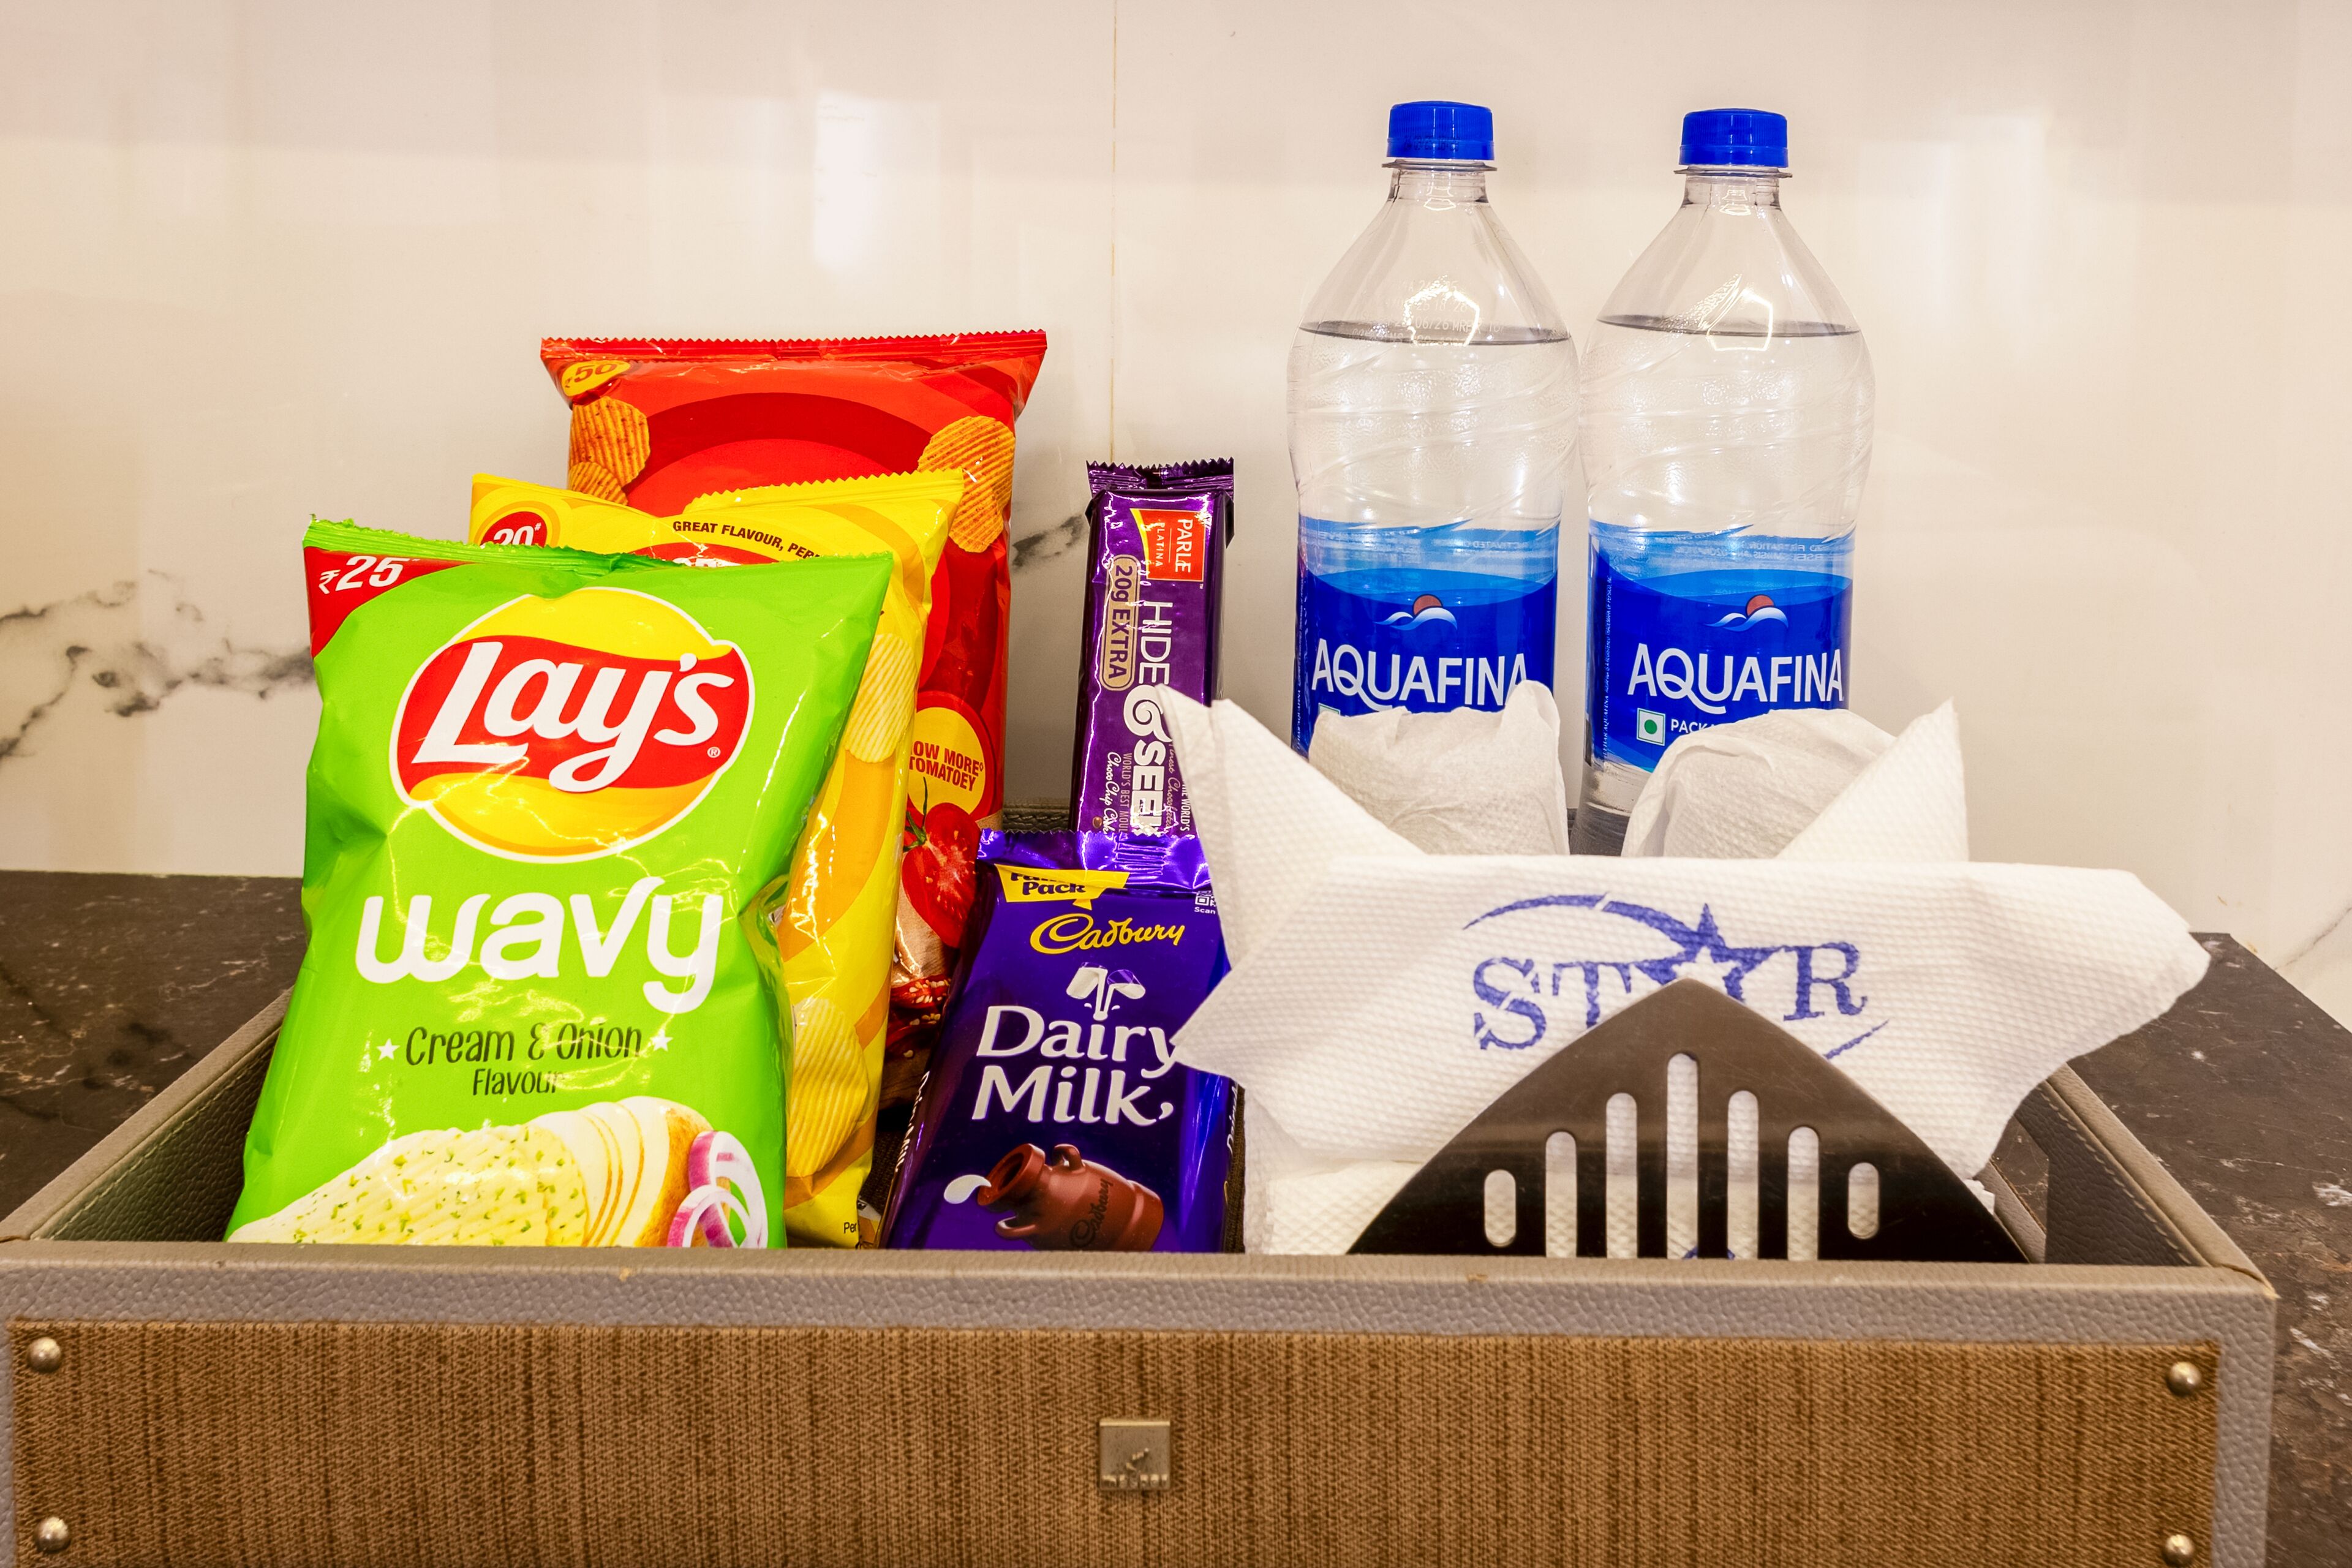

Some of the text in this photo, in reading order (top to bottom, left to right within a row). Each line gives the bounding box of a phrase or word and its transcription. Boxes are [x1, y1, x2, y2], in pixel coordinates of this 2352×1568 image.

[673, 521, 821, 560] GREAT FLAVOUR, PER
[1154, 521, 1166, 568] PLATINA
[1174, 518, 1194, 574] PARLE
[1107, 565, 1133, 680] 20g EXTRA
[1138, 600, 1174, 685] HIDE
[1311, 638, 1527, 712] AQUAFINA
[1627, 642, 1844, 715] AQUAFINA
[412, 641, 735, 793] Lay's
[1670, 718, 1715, 734] PACK
[910, 740, 940, 760] OW
[1121, 753, 1133, 788] WORLD'S
[909, 756, 977, 792] TOMATOEY
[1119, 790, 1131, 808] BEST
[1180, 798, 1191, 832] WORLD'S
[1022, 881, 1086, 895] Pack
[355, 876, 724, 1014] wavy
[1030, 913, 1186, 955] Cadbury
[405, 1022, 643, 1066] Cream & Onion
[976, 1005, 1176, 1079] Dairy
[472, 1068, 564, 1096] Flavour
